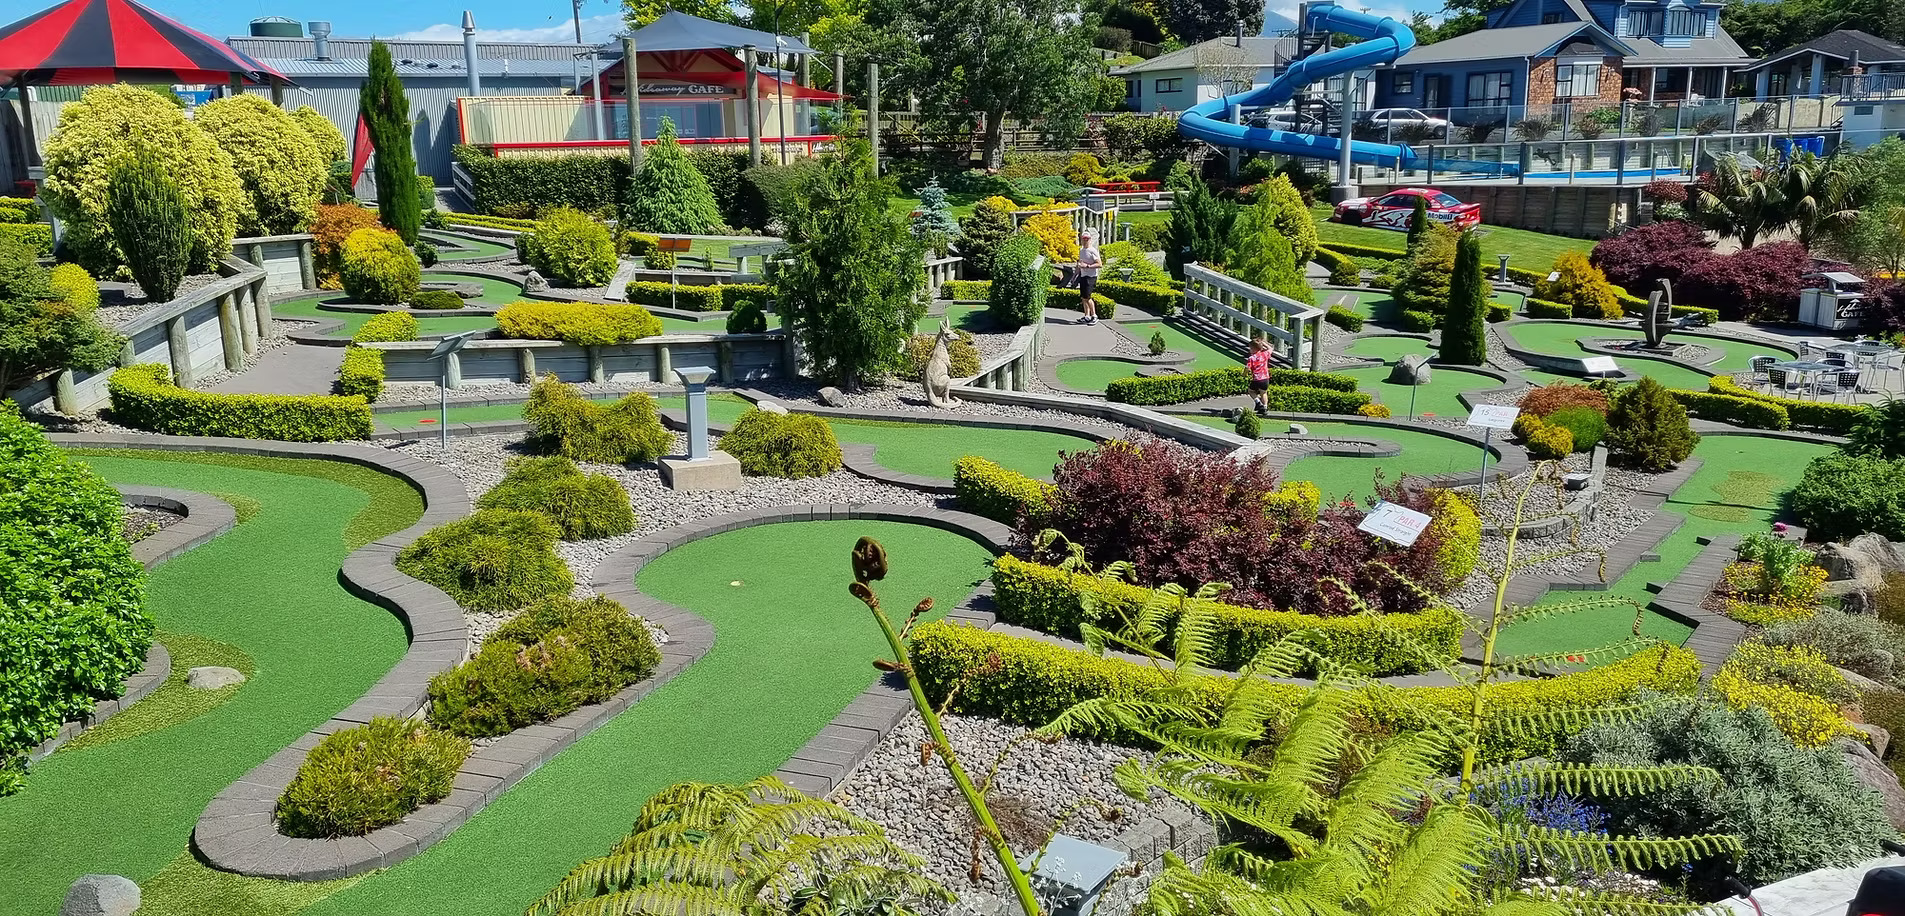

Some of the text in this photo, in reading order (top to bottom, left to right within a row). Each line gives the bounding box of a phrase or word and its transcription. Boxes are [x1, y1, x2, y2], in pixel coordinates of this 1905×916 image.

[620, 83, 724, 96] ideaway CAFE
[1383, 509, 1393, 518] 7
[1398, 515, 1415, 527] PAR
